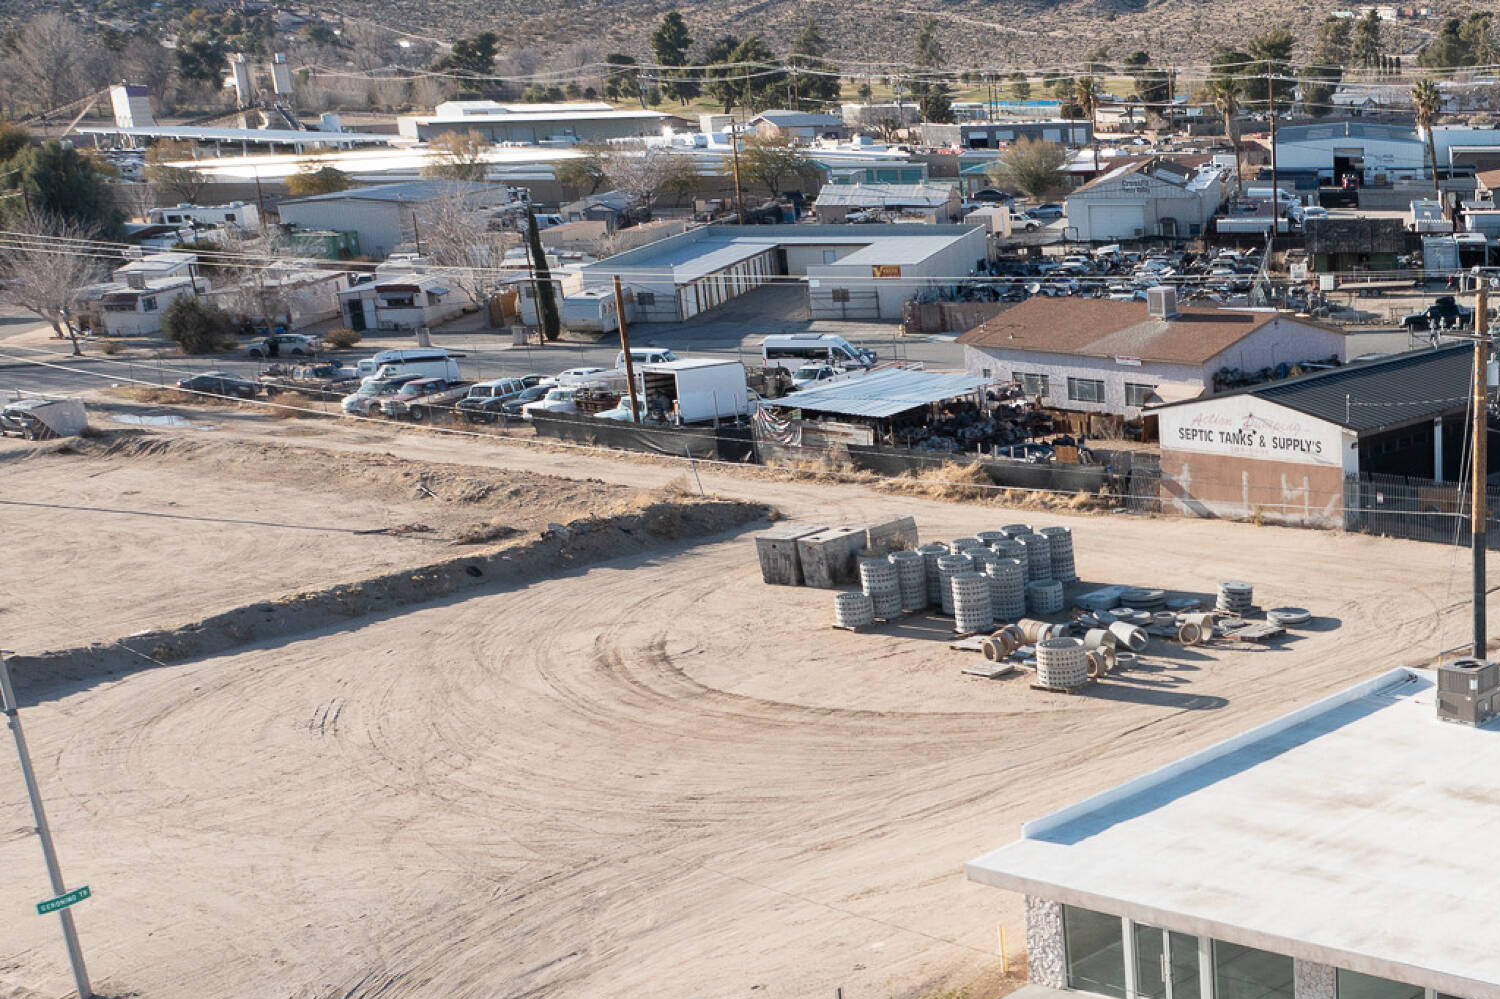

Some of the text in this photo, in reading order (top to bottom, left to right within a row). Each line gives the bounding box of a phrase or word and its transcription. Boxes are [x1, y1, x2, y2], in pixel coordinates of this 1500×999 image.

[1178, 427, 1214, 443] SEPTIC
[1218, 430, 1254, 446] TANKS
[1259, 435, 1267, 448] &
[1272, 436, 1323, 454] SUPPLY'S
